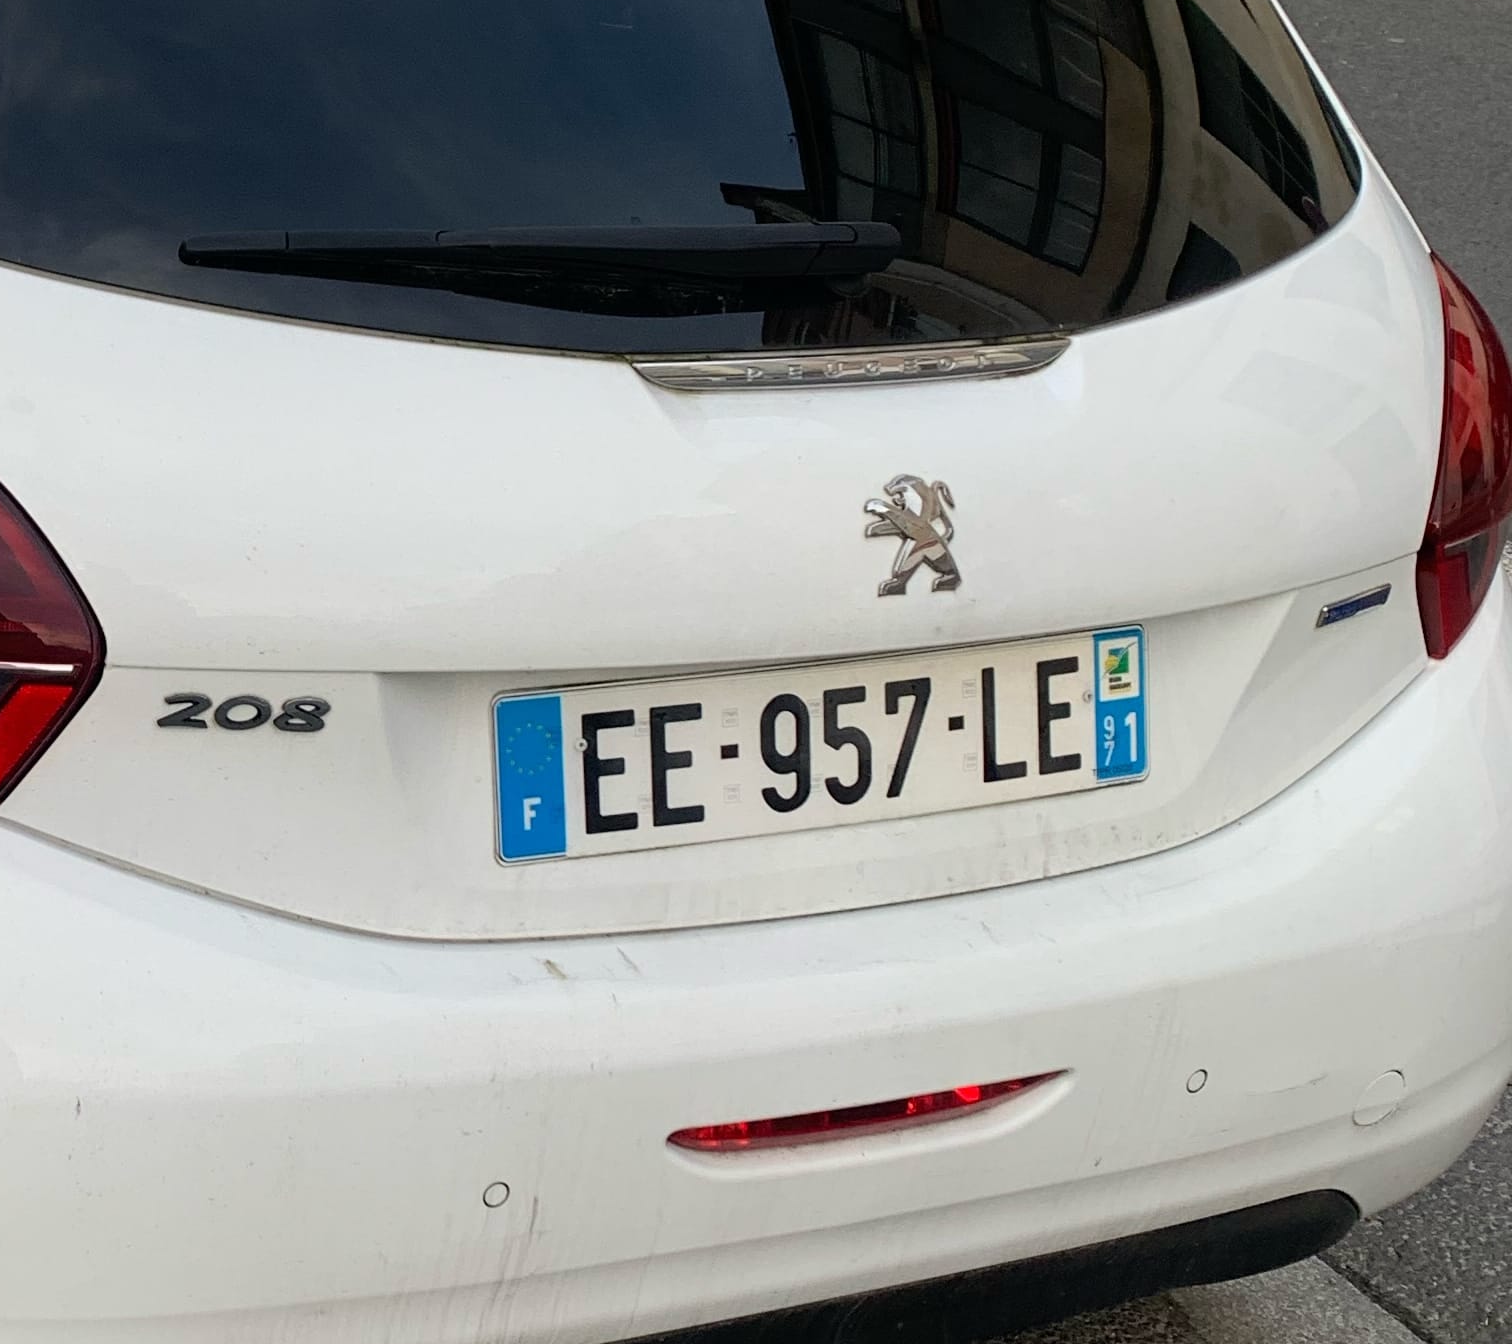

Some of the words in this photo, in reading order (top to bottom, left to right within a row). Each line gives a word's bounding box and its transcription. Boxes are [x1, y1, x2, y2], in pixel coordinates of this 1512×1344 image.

[745, 352, 988, 382] PEUGEOT
[156, 692, 332, 733] 208
[581, 656, 1082, 835] EE-957-LE
[522, 796, 542, 831] F
